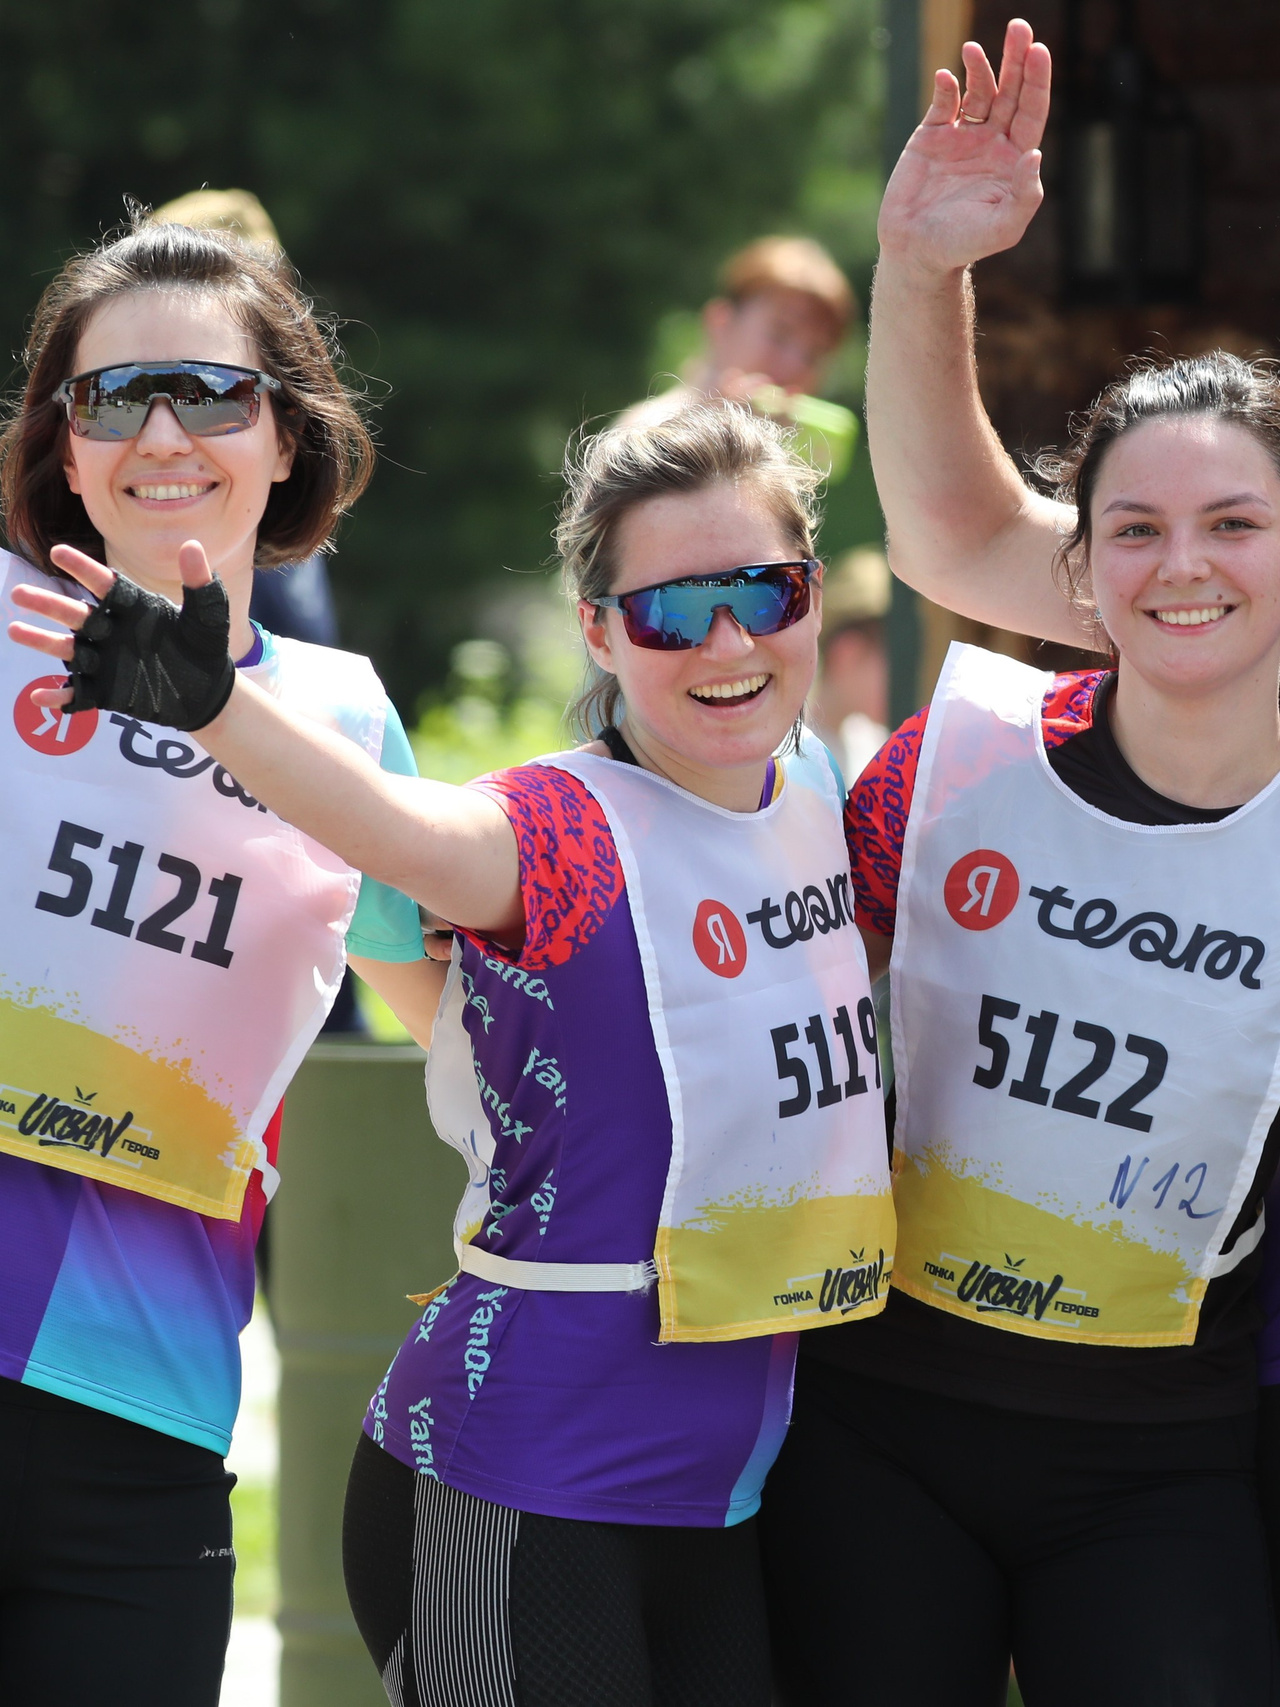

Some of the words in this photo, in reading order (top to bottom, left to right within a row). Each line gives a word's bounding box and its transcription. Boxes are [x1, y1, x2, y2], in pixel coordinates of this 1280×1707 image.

[35, 820, 243, 969] 5121
[746, 872, 855, 949] team
[1029, 885, 1266, 990] team
[770, 996, 882, 1119] 5119
[972, 994, 1168, 1133] 5122
[18, 1093, 134, 1158] URBAN
[121, 1138, 161, 1160] ГЕРОЕВ
[1152, 1161, 1224, 1219] 12
[773, 1290, 814, 1306] ГОНКА
[818, 1248, 885, 1313] URBAN
[923, 1261, 955, 1282] ГОНКА
[957, 1260, 1064, 1321] URBAN
[1054, 1301, 1100, 1318] ГЕРОЕВ
